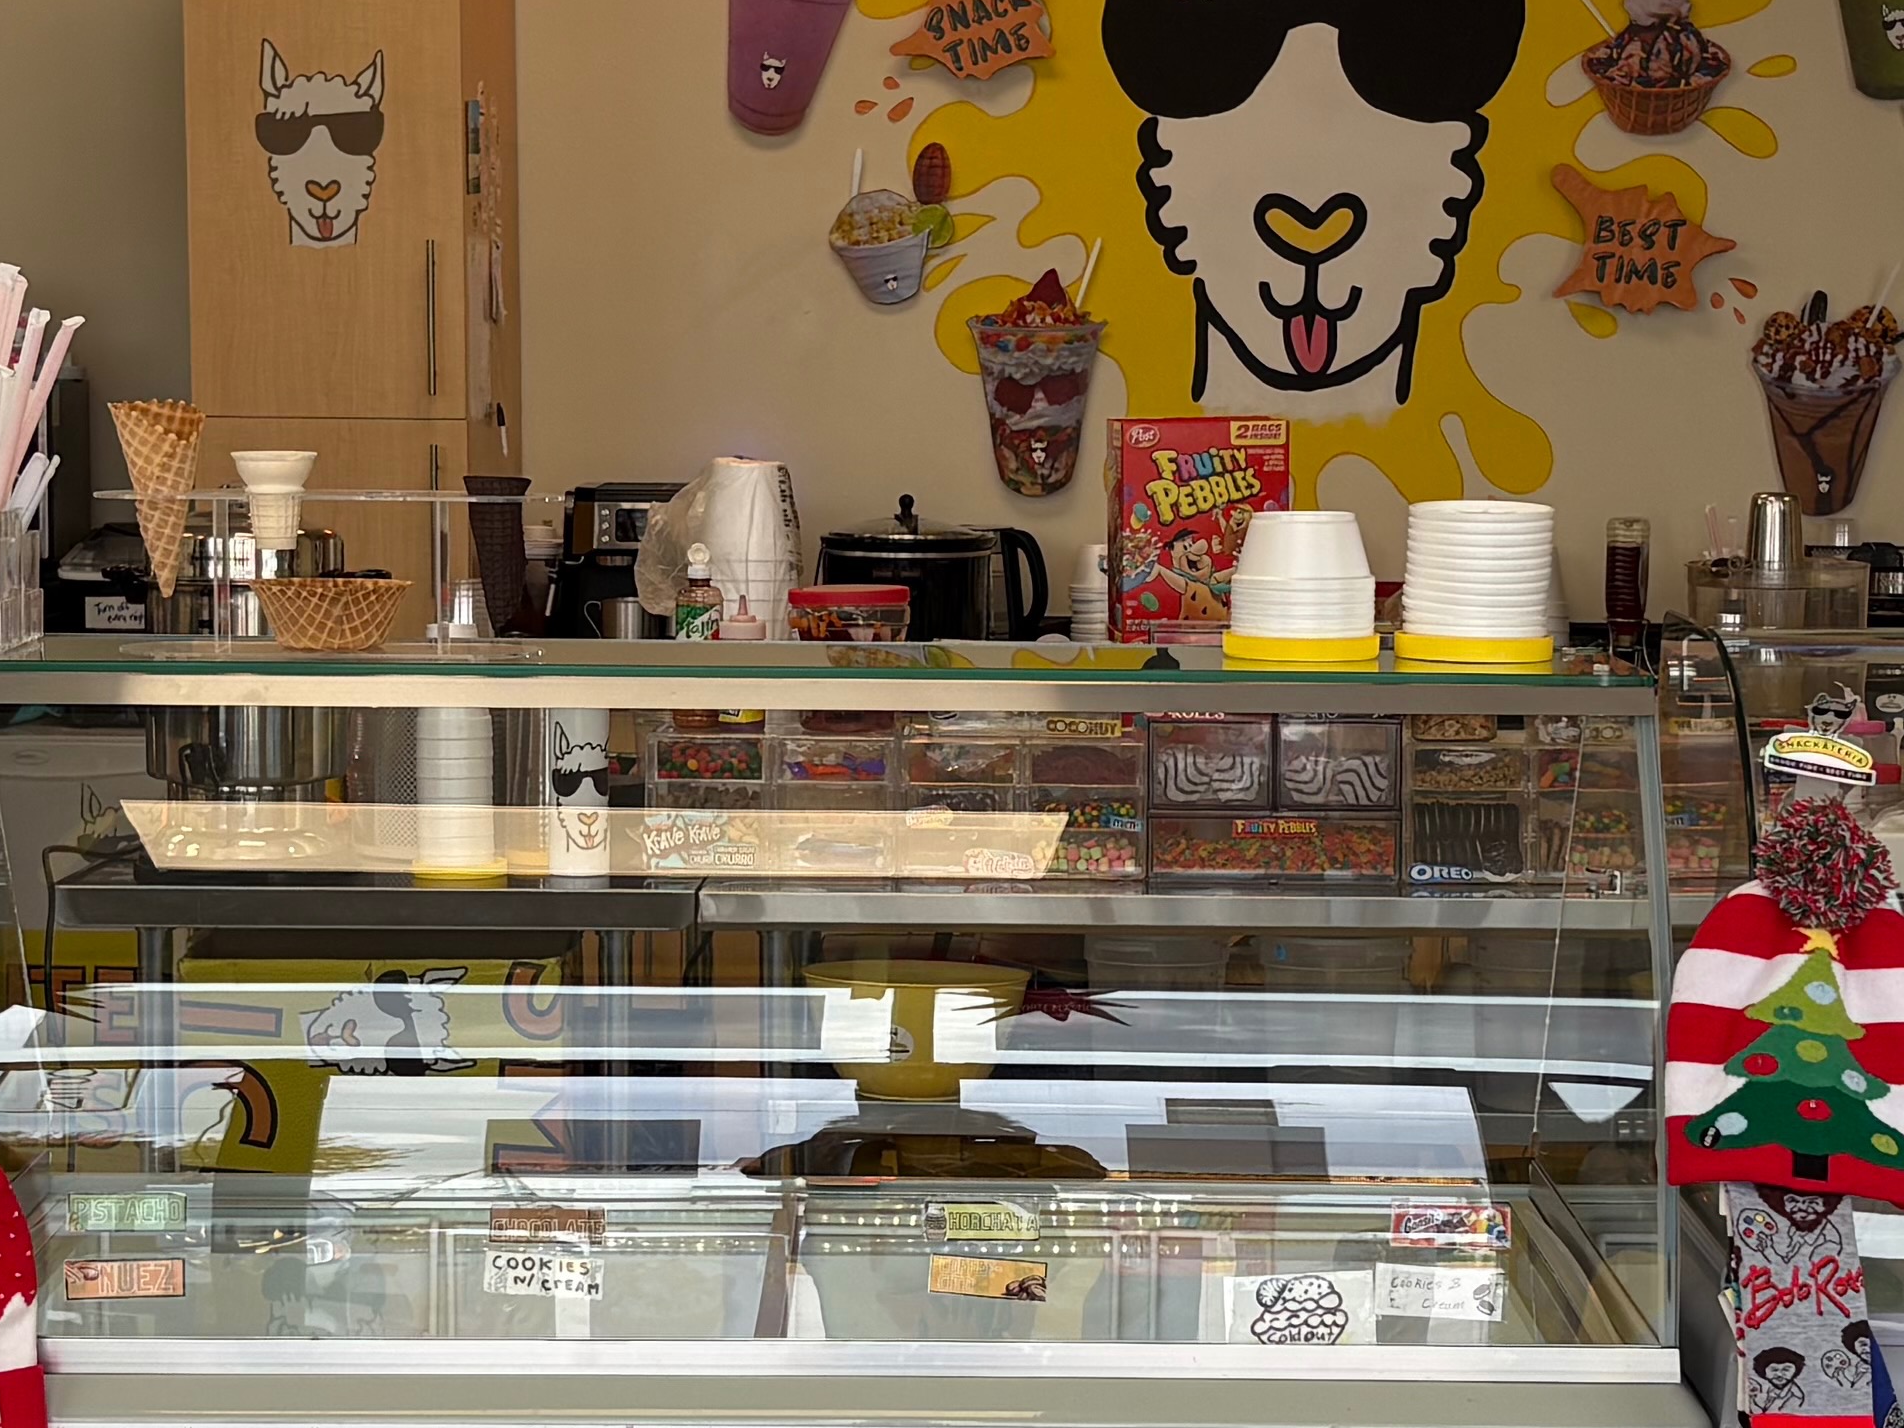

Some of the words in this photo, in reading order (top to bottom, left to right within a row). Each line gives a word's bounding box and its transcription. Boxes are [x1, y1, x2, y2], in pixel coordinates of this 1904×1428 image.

[941, 21, 1032, 73] TIME
[1591, 214, 1689, 252] BEST
[1592, 250, 1684, 292] TIME
[1151, 446, 1247, 481] FRUITY
[1145, 467, 1263, 526] PEBBLES
[1410, 864, 1473, 882] OREO
[74, 1196, 182, 1226] PISTACHO
[99, 1261, 175, 1295] NUEZ
[493, 1253, 591, 1276] COOKIES
